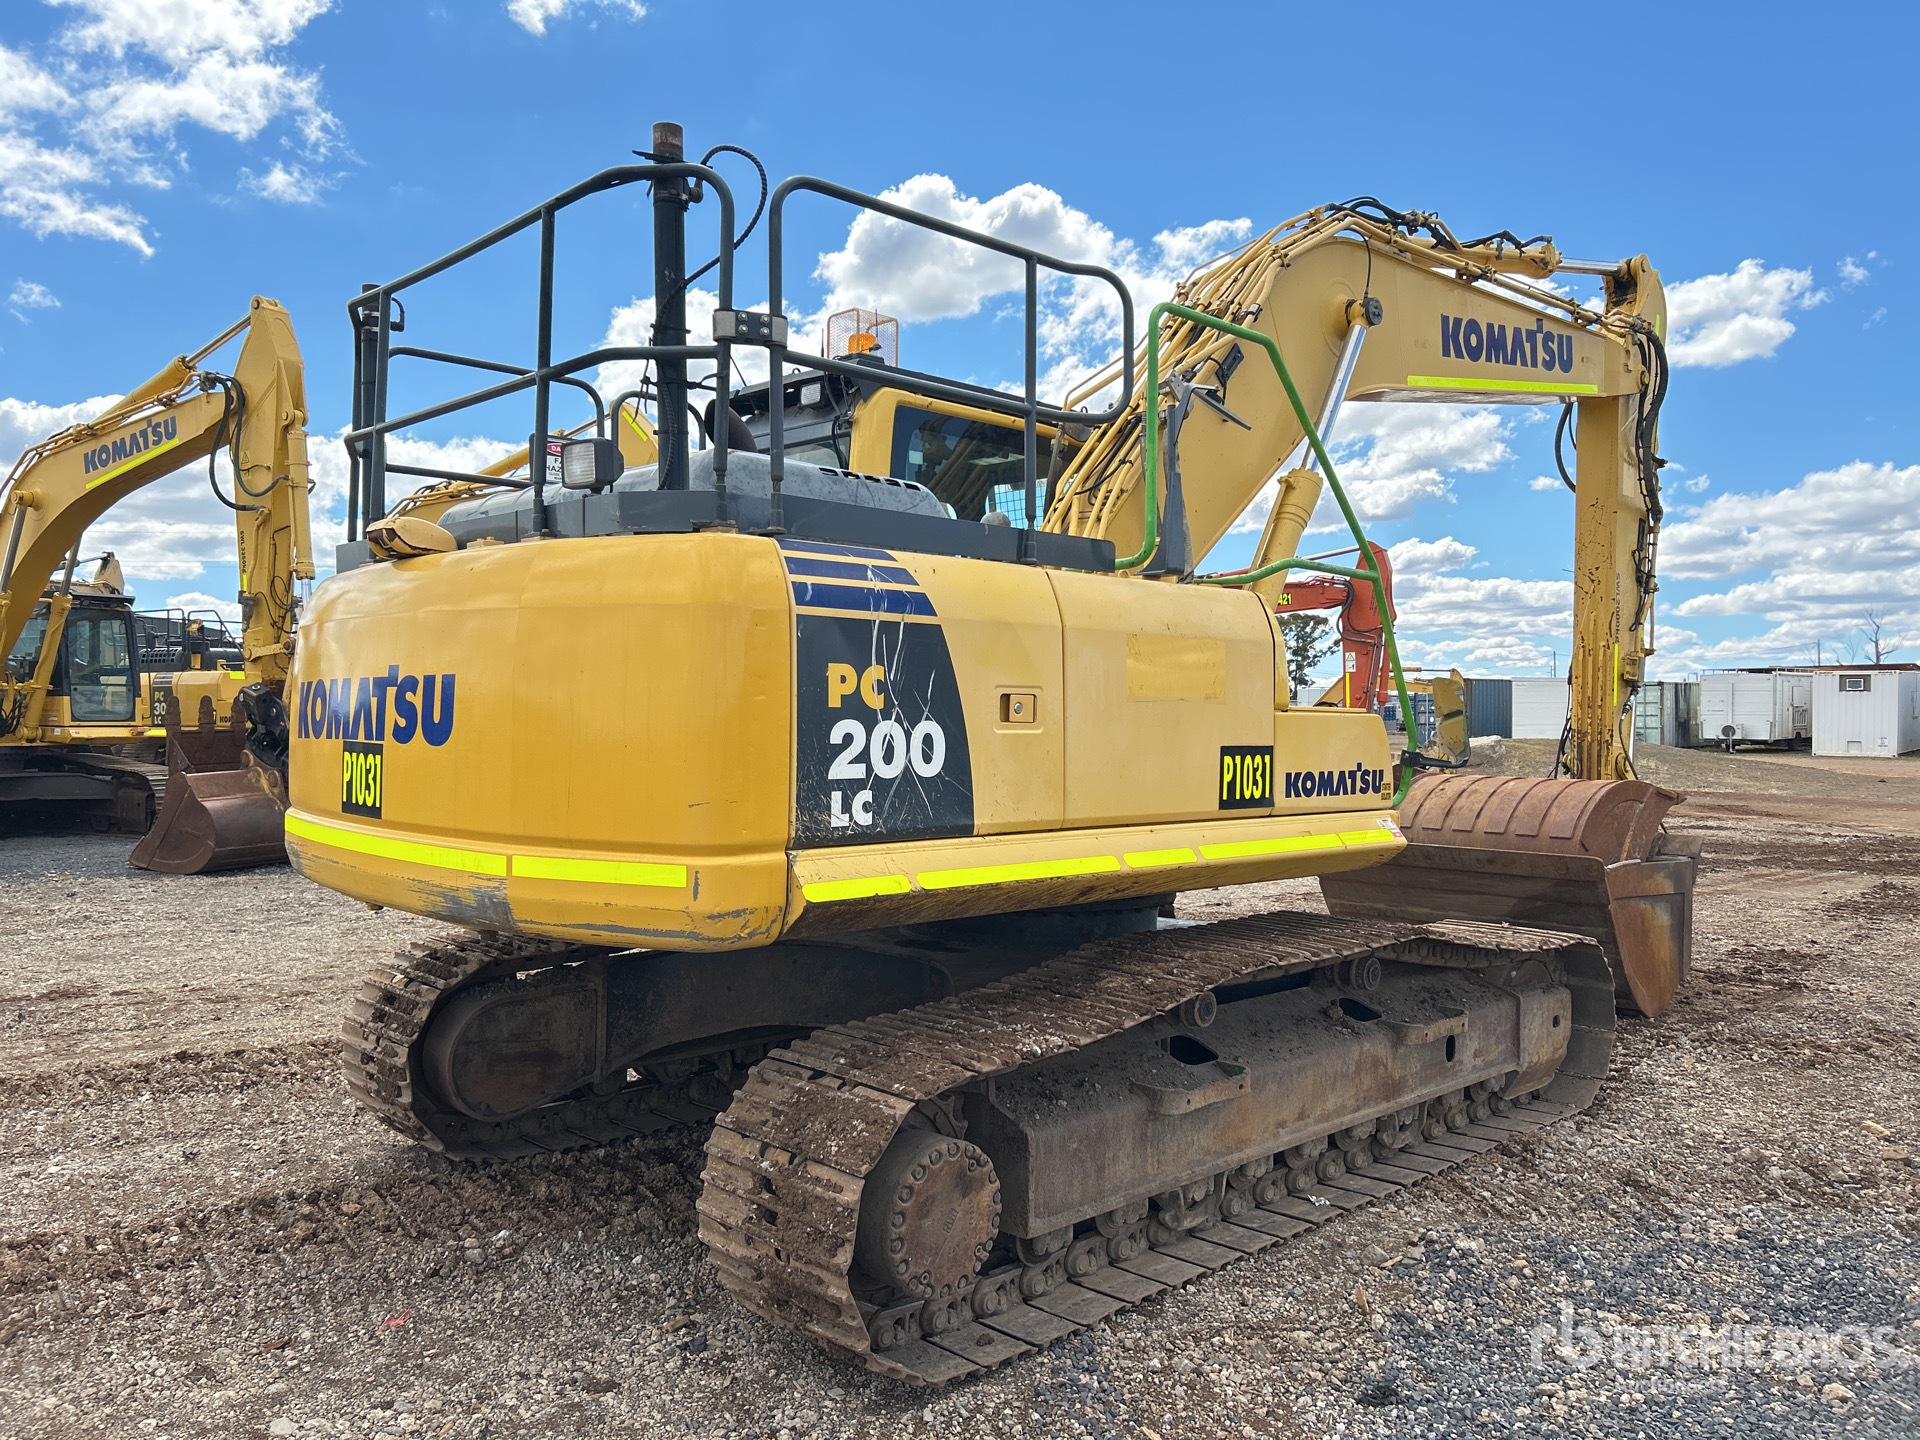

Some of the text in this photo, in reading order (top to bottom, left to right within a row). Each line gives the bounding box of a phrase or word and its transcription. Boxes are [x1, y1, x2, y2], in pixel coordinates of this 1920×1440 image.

[1441, 313, 1573, 374] KOMATSU
[83, 415, 177, 475] KOMATSU
[153, 702, 167, 715] 30
[154, 691, 164, 701] PC
[297, 664, 456, 747] KOMATSU
[827, 663, 885, 710] PC
[154, 716, 162, 724] LC
[828, 719, 946, 780] 200
[342, 751, 381, 808] P1031
[1222, 754, 1271, 801] P1031
[1285, 762, 1384, 799] KOMATSU
[830, 789, 873, 828] LC
